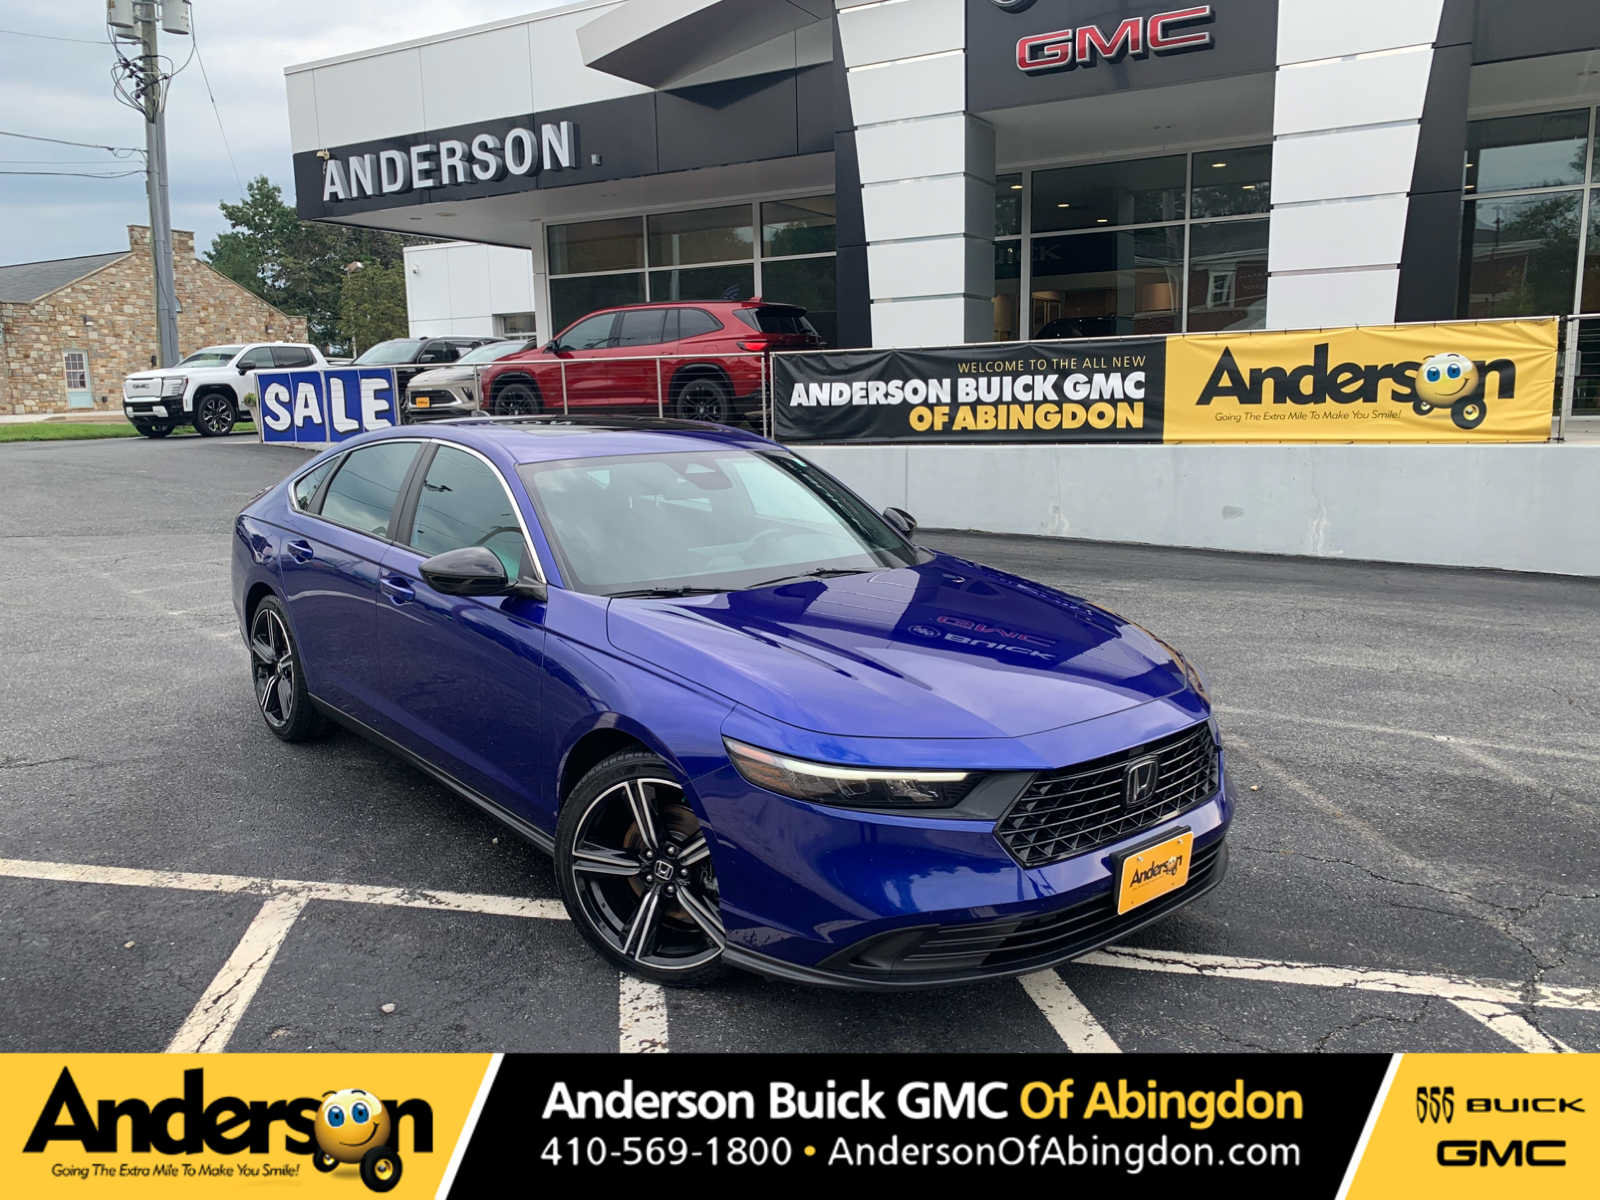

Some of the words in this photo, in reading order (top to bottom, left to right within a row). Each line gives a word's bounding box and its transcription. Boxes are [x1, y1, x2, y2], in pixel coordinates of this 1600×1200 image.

[1016, 4, 1211, 72] GMC
[322, 120, 573, 201] ANDERSON
[957, 359, 1025, 374] WELCOME
[1029, 358, 1047, 371] TO
[1052, 357, 1077, 370] THE
[1082, 356, 1108, 369] ALL
[1112, 355, 1146, 368] NEW
[264, 377, 393, 433] SALE
[789, 378, 951, 407] ANDERSON
[957, 374, 1059, 403] BUICK
[1063, 371, 1146, 400] GMC
[908, 405, 950, 432] OF
[952, 401, 1144, 430] ABINGDON
[1215, 412, 1242, 423] Going
[1244, 411, 1262, 421] The
[1263, 411, 1286, 421] Extra
[1287, 410, 1308, 420] Mile
[1310, 410, 1320, 420] To
[1322, 410, 1350, 420] Make
[1352, 410, 1370, 420] You
[1371, 409, 1402, 419] Smile!
